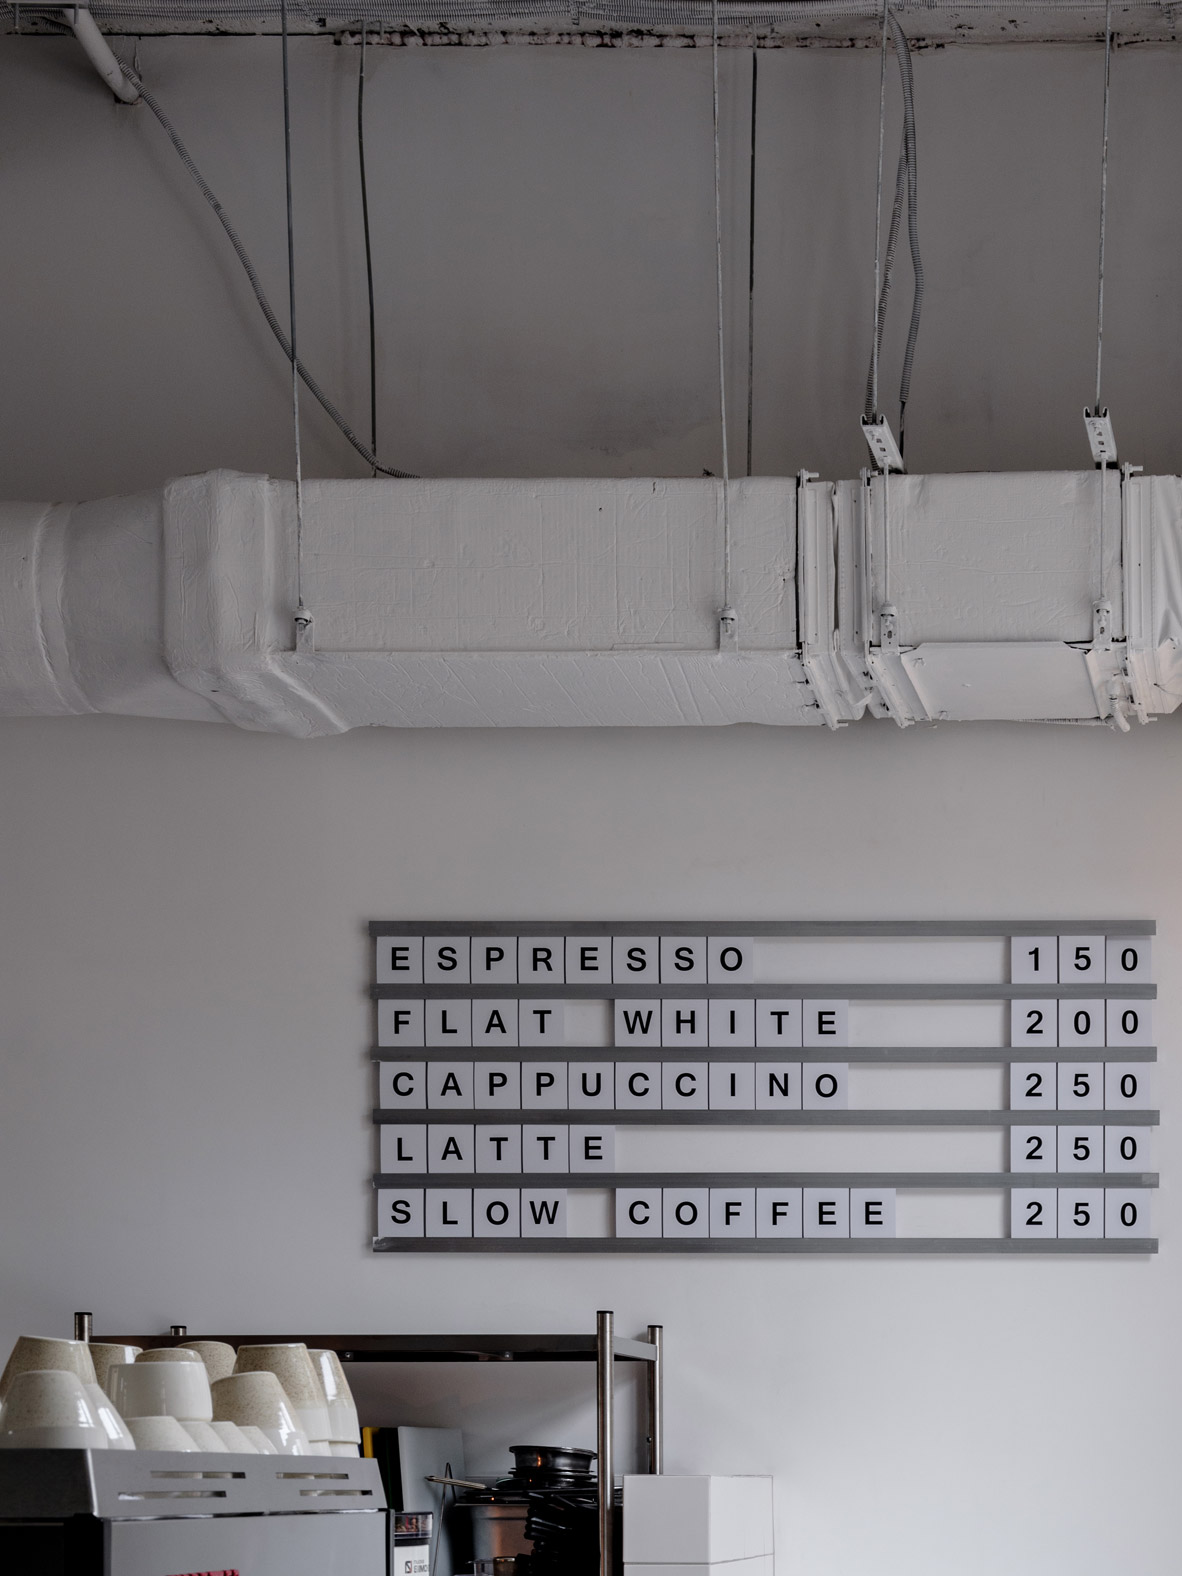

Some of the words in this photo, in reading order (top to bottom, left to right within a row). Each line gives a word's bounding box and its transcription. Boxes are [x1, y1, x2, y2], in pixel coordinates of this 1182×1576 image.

[391, 946, 744, 972] ESPRESSO
[1028, 946, 1139, 972] 150
[393, 1009, 552, 1035] FLAT
[622, 1009, 838, 1035] WHITE
[1026, 1009, 1139, 1035] 200
[391, 1072, 839, 1099] CAPPUCCINO
[1025, 1072, 1139, 1099] 250
[396, 1136, 604, 1162] LATTE
[1025, 1135, 1138, 1162] 250
[390, 1199, 560, 1226] SLOW
[628, 1200, 884, 1226] COFFEE
[1025, 1201, 1138, 1227] 250
